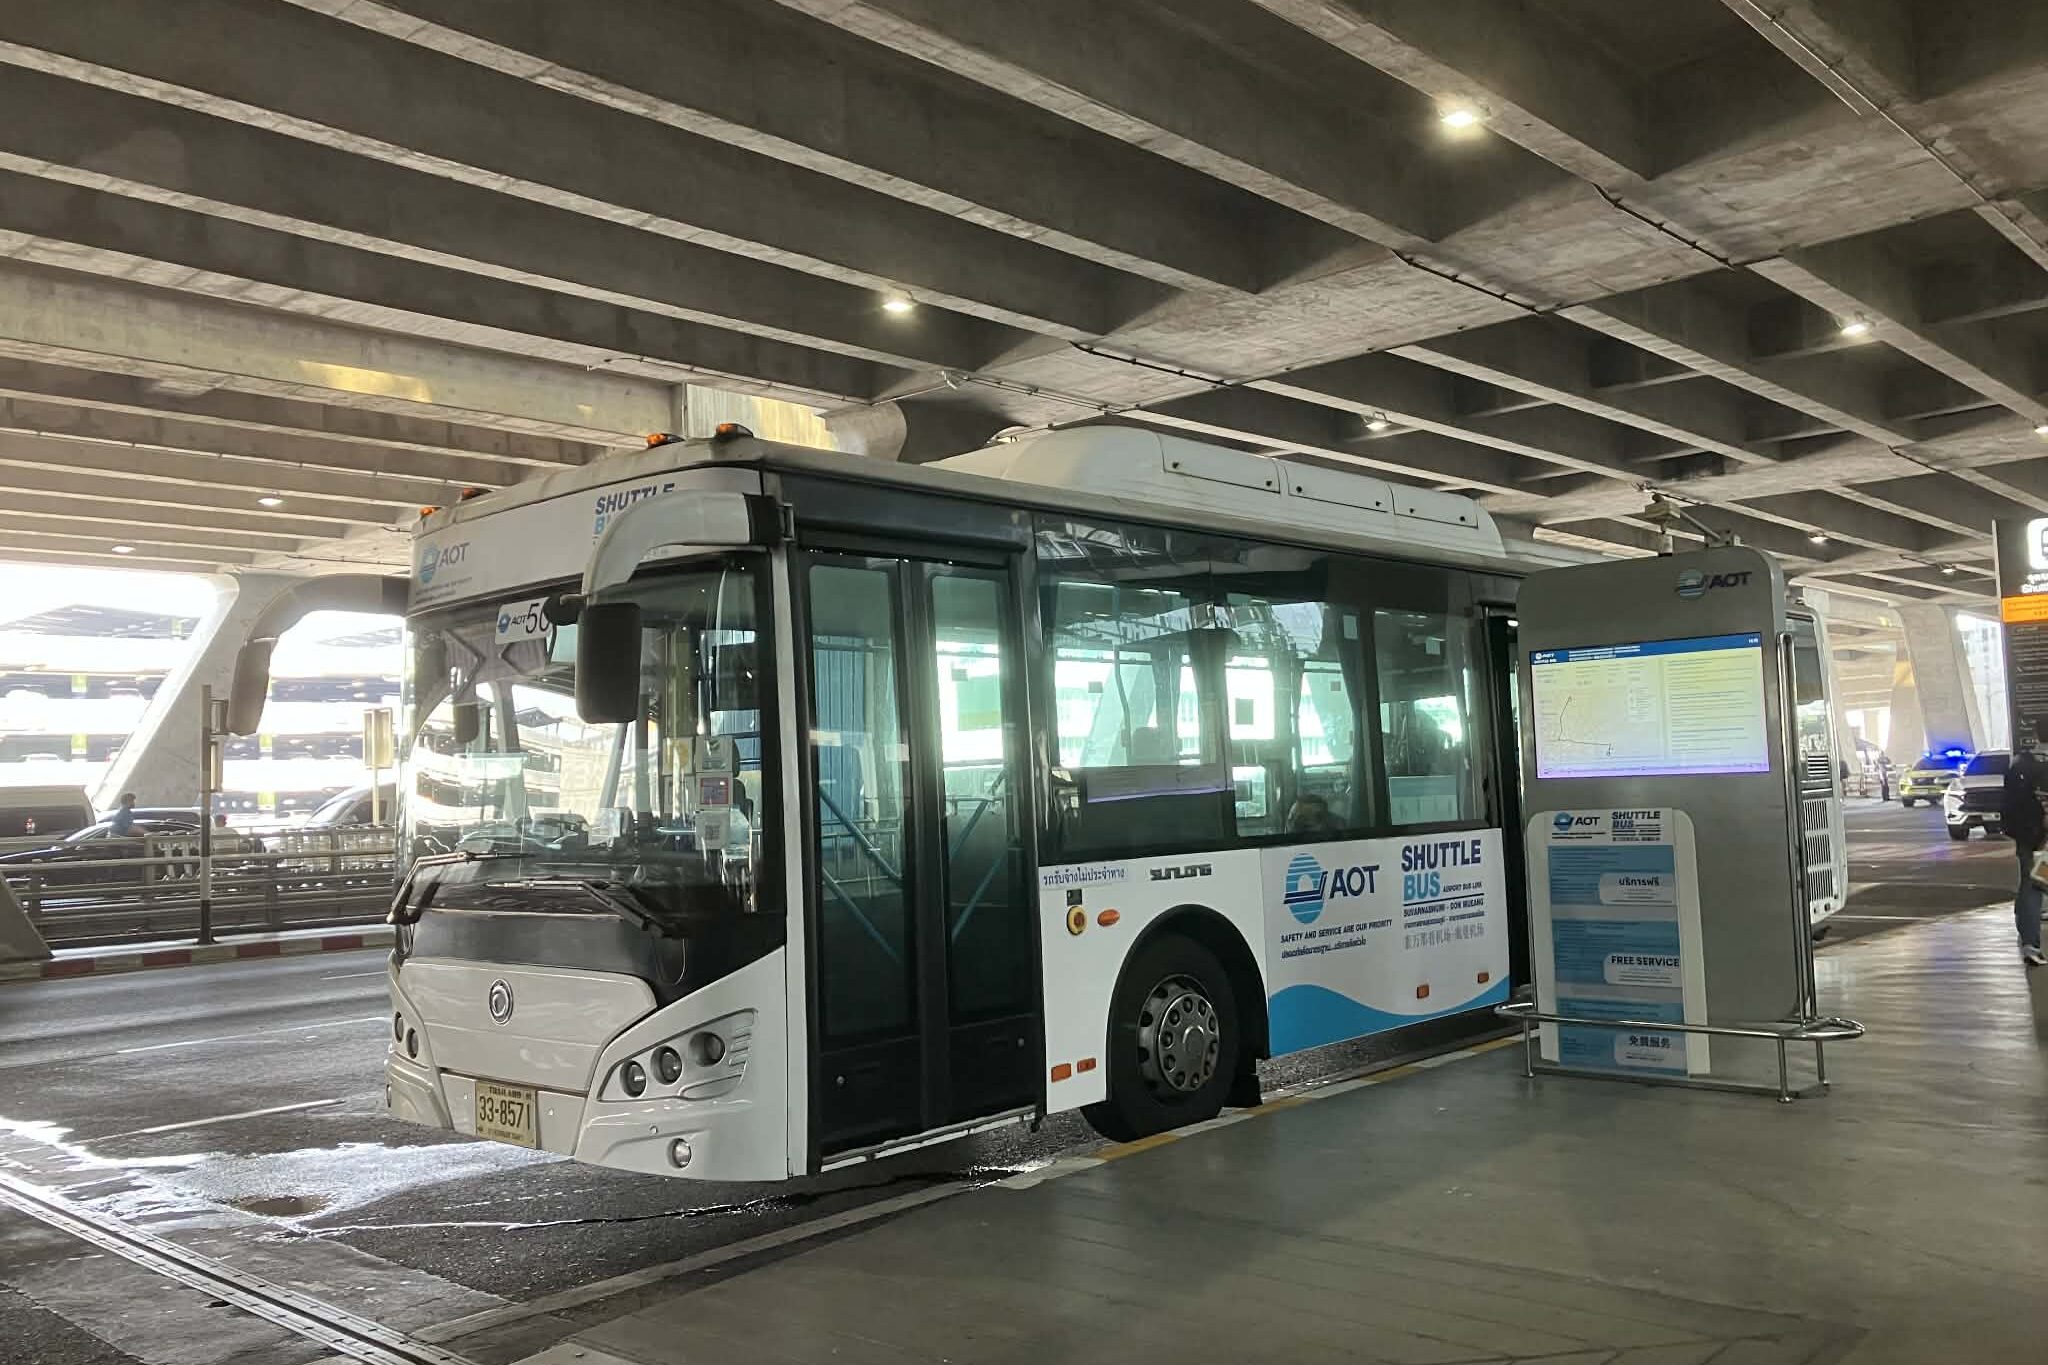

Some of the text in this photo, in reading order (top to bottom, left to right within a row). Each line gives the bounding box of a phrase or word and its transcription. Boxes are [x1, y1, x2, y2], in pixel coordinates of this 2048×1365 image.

[440, 542, 471, 567] AOT
[1709, 571, 1753, 590] AOT
[1575, 816, 1601, 826] AOT
[1611, 811, 1661, 820] SHUTTLE
[1612, 820, 1634, 829] BUS
[1401, 839, 1482, 872] SHUTTLE
[1329, 865, 1380, 899] AOT
[1403, 871, 1441, 901] BUS
[1450, 901, 1462, 911] DON
[1281, 932, 1303, 944] SAFETY
[1304, 930, 1317, 940] AND
[1319, 926, 1342, 938] SERVICE
[1343, 924, 1355, 933] ARE
[1356, 922, 1367, 931] OUR
[1368, 918, 1393, 930] PRIORITY
[1611, 955, 1680, 967] FREE SERVICE
[479, 1095, 530, 1131] 33-8571
